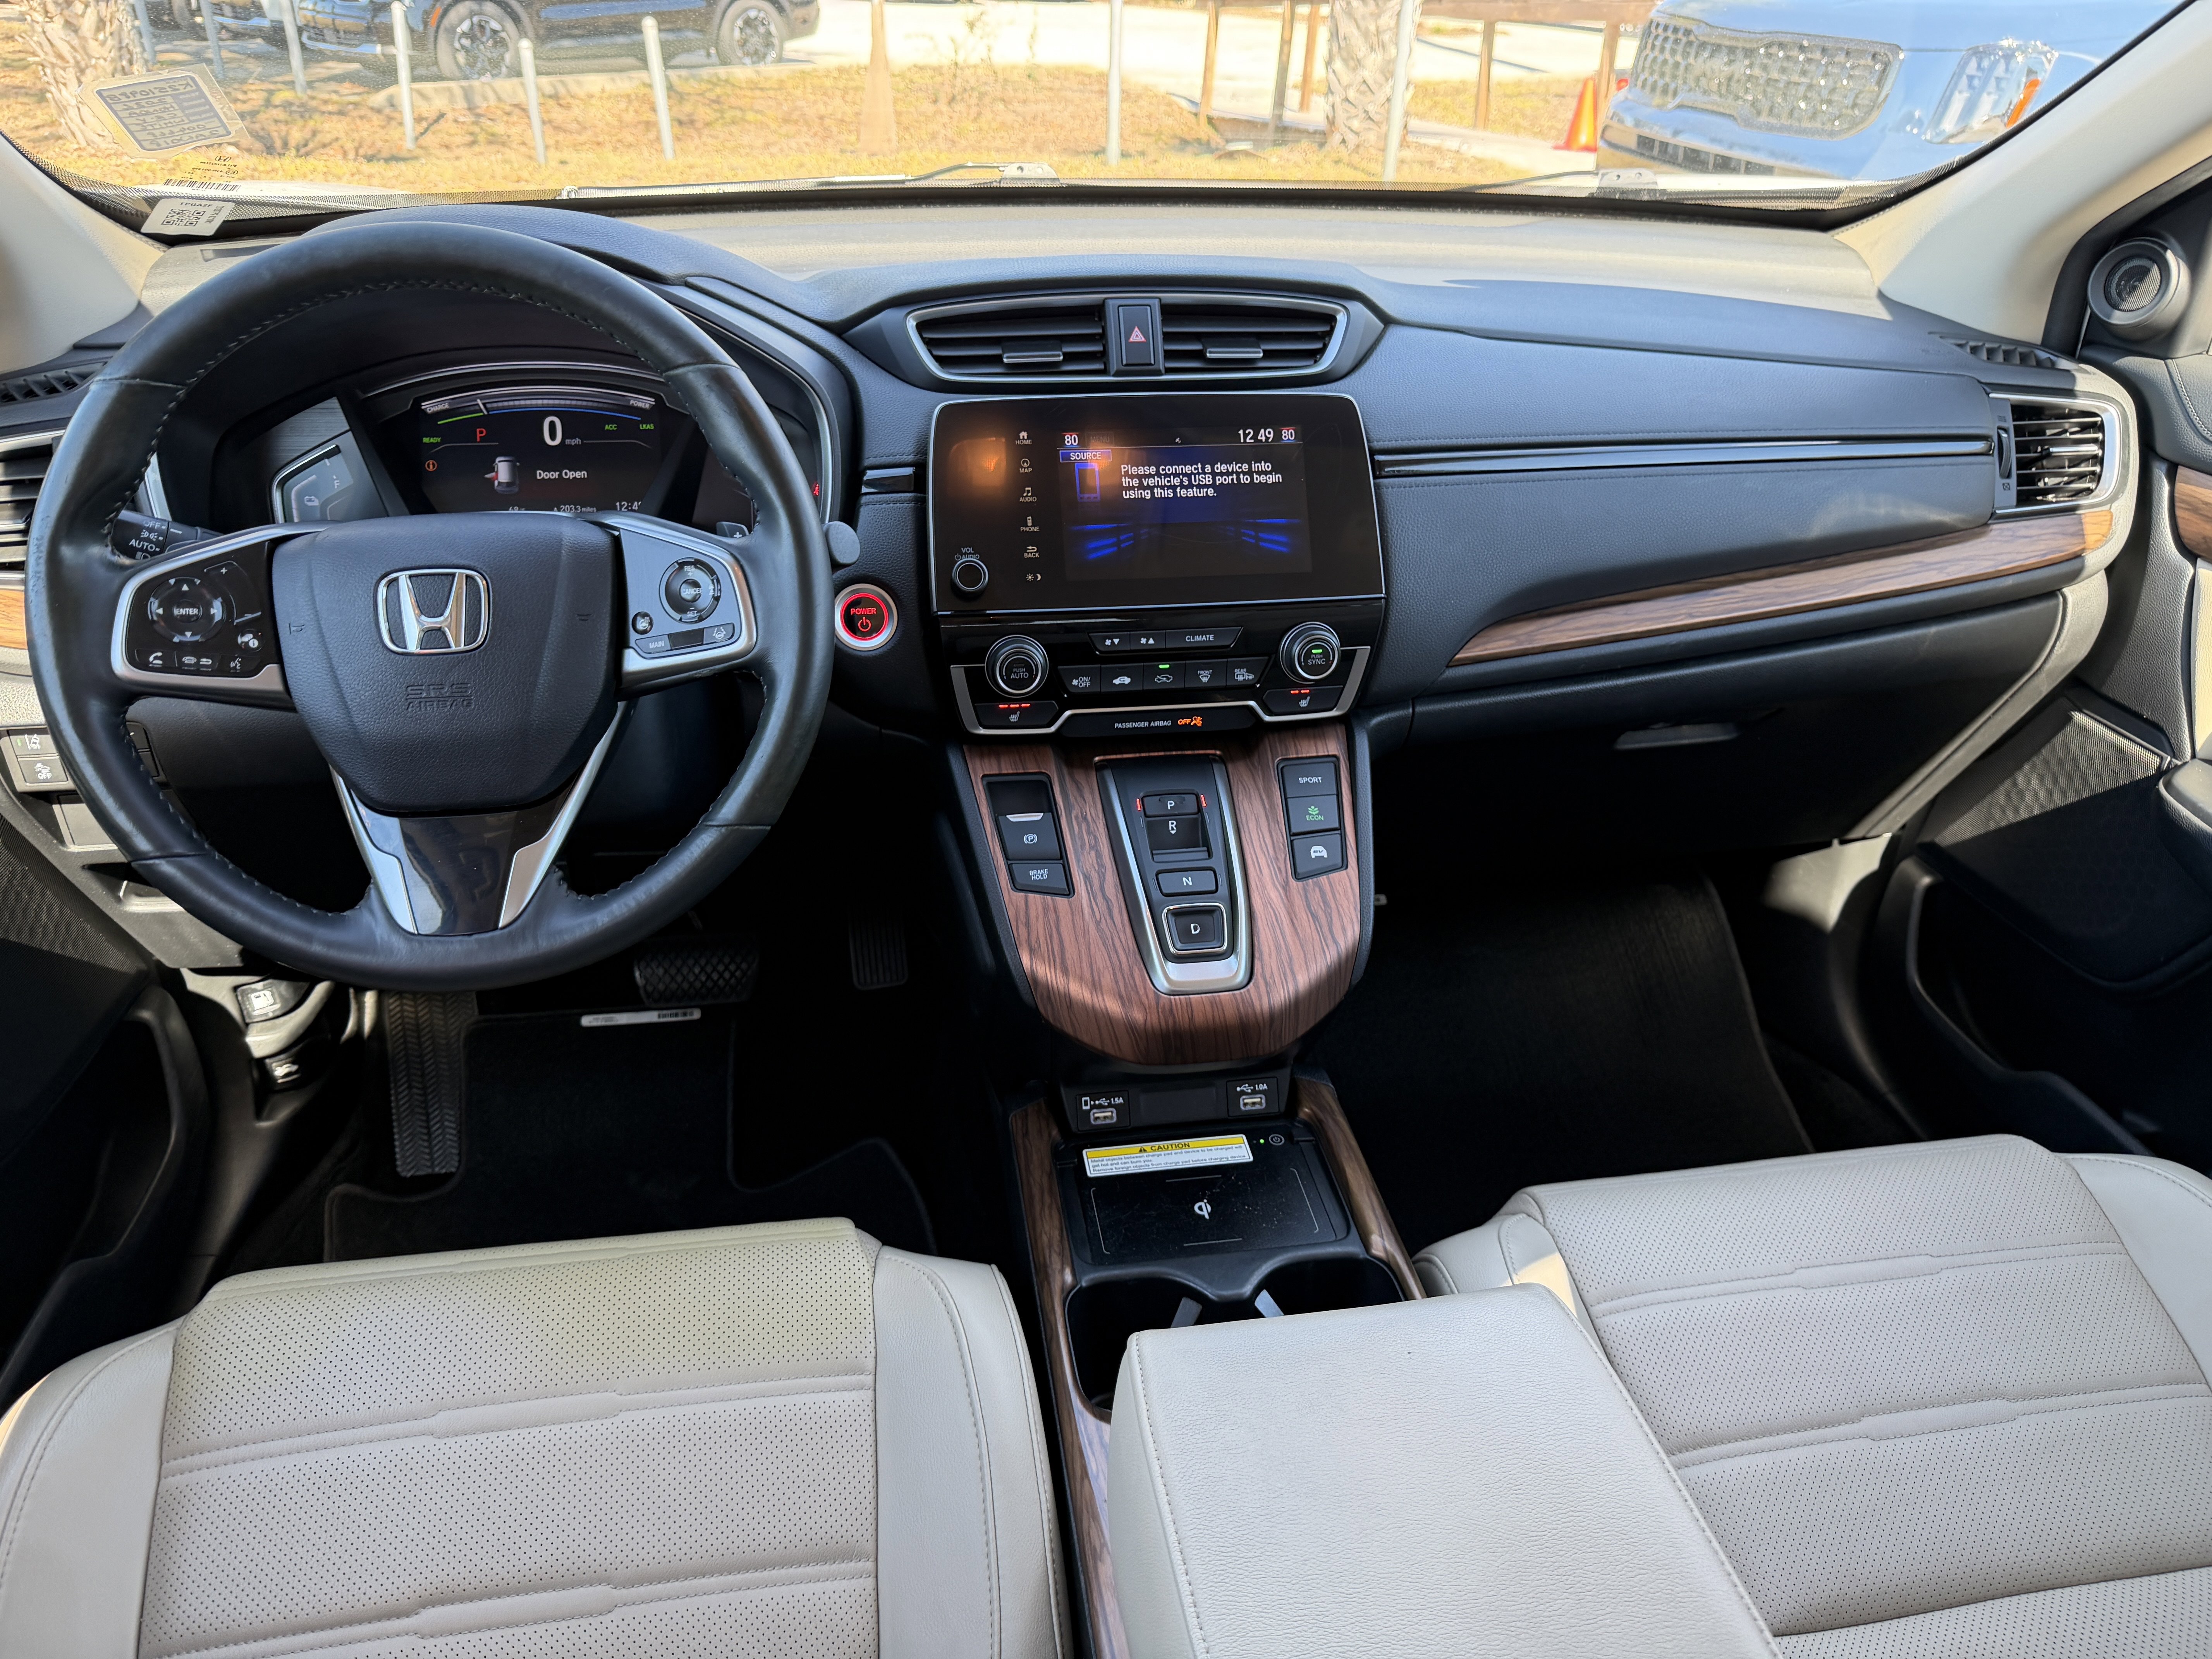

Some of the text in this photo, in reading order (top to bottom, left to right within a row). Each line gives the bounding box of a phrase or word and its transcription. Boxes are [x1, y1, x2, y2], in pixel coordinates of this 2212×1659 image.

[427, 403, 449, 413] CHARGE
[630, 400, 650, 408] POWER
[476, 428, 486, 442] P
[543, 416, 562, 446] 0
[1282, 430, 1295, 440] 80
[1064, 434, 1079, 445] 80
[1070, 452, 1102, 460] SOURCE
[1121, 464, 1156, 475] Please
[1159, 463, 1203, 474] connect
[1214, 462, 1249, 472] device
[1252, 461, 1272, 471] into
[536, 469, 587, 480] Door Open
[1122, 472, 1282, 487] the vehicle's USB port to begin
[1123, 486, 1217, 499] using this feature.
[616, 501, 641, 511] 12:4
[143, 520, 161, 529] OFF
[129, 539, 155, 551] AUTO
[649, 641, 664, 649] MAIN
[406, 683, 471, 697] SRS
[406, 699, 473, 711] AIRBAG
[1167, 801, 1175, 810] P
[1169, 820, 1176, 830] R
[1183, 877, 1192, 885] N
[1191, 923, 1200, 934] D
[1150, 1142, 1190, 1151] CAUTION
